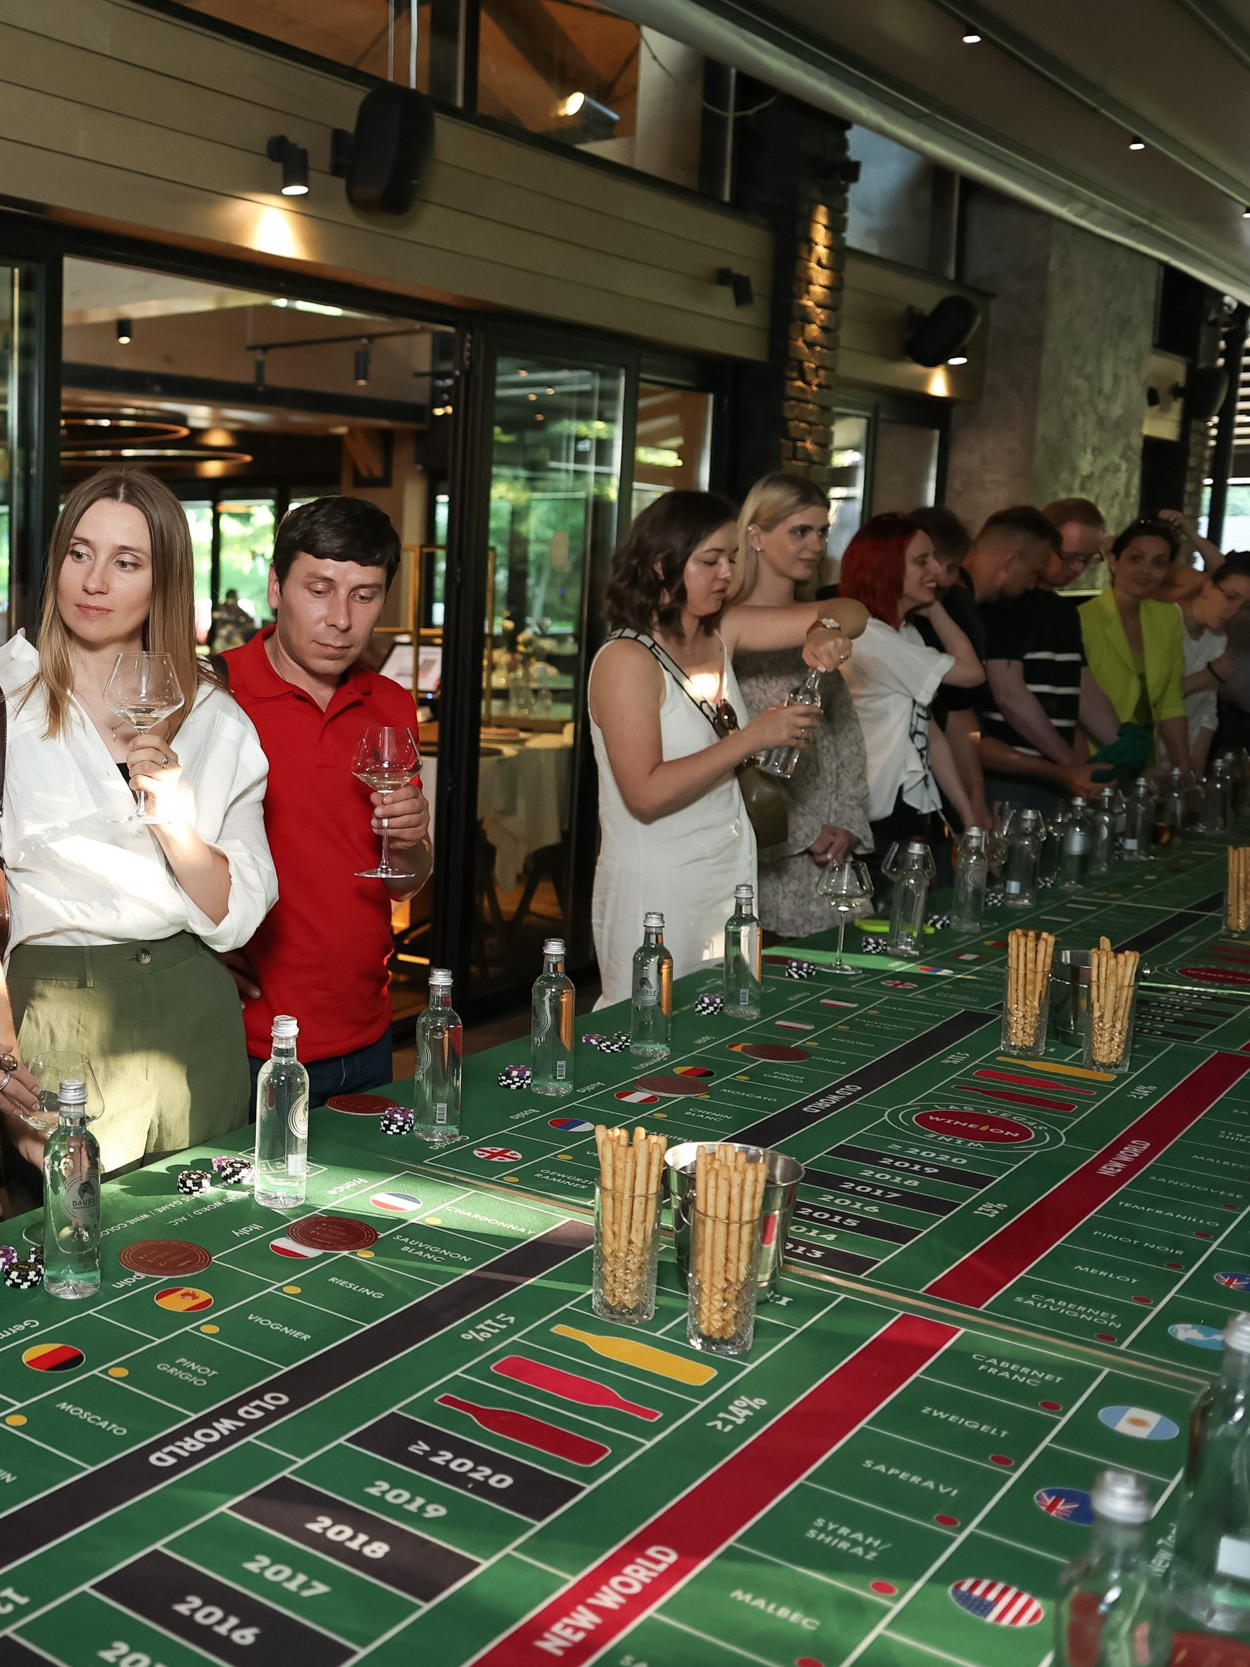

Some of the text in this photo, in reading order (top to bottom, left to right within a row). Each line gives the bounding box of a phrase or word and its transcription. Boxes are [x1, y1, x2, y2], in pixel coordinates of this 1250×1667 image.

[719, 1088, 779, 1102] MOSCATO
[683, 1110, 725, 1123] BLANC
[688, 1107, 734, 1120] CHENIN
[927, 1115, 1021, 1138] WINE ON
[877, 1156, 940, 1175] 2019
[1096, 1139, 1151, 1178] NEW WORLD
[533, 1172, 588, 1191] RAMINER
[838, 1181, 903, 1200] 2017
[858, 1169, 921, 1188] 2018
[1149, 1175, 1245, 1200] SANGIOVESE
[817, 1194, 881, 1214] 2016
[1117, 1200, 1221, 1228] TEMPRANILLO
[231, 1222, 265, 1238] Italy
[445, 1205, 537, 1236] CHARDONNAY
[795, 1207, 861, 1228] 2015
[789, 1225, 838, 1242] 014
[1092, 1230, 1185, 1256] PINOT NOIR
[392, 1234, 473, 1263] SAUVIGNON
[399, 1244, 446, 1264] BLANC
[111, 1271, 148, 1290] pain
[327, 1275, 385, 1300] RIESLING
[1073, 1264, 1139, 1285] MERLOT
[1013, 1295, 1123, 1330] SAUVIGNON
[1030, 1293, 1119, 1320] CABERNET
[247, 1313, 312, 1342] VIOGNIER
[156, 1362, 208, 1388] GRIGIO
[174, 1356, 219, 1378] PINOT
[971, 1352, 1065, 1384] CABERNET
[977, 1364, 1042, 1387] FRANC
[55, 1400, 128, 1437] MOSCATO
[148, 1392, 290, 1468] OLD WORLD
[920, 1405, 1010, 1439] ZWEIGELT
[861, 1458, 960, 1498] SAPERAVI
[363, 1479, 449, 1519] 2019
[303, 1514, 391, 1560] 2018
[805, 1528, 880, 1562] SHIRAZ
[812, 1517, 893, 1552] SYRAH/
[241, 1553, 332, 1599] 2017
[532, 1544, 680, 1658] NEW WORLD
[728, 1588, 822, 1632] MALBEC
[170, 1594, 263, 1648] 2016
